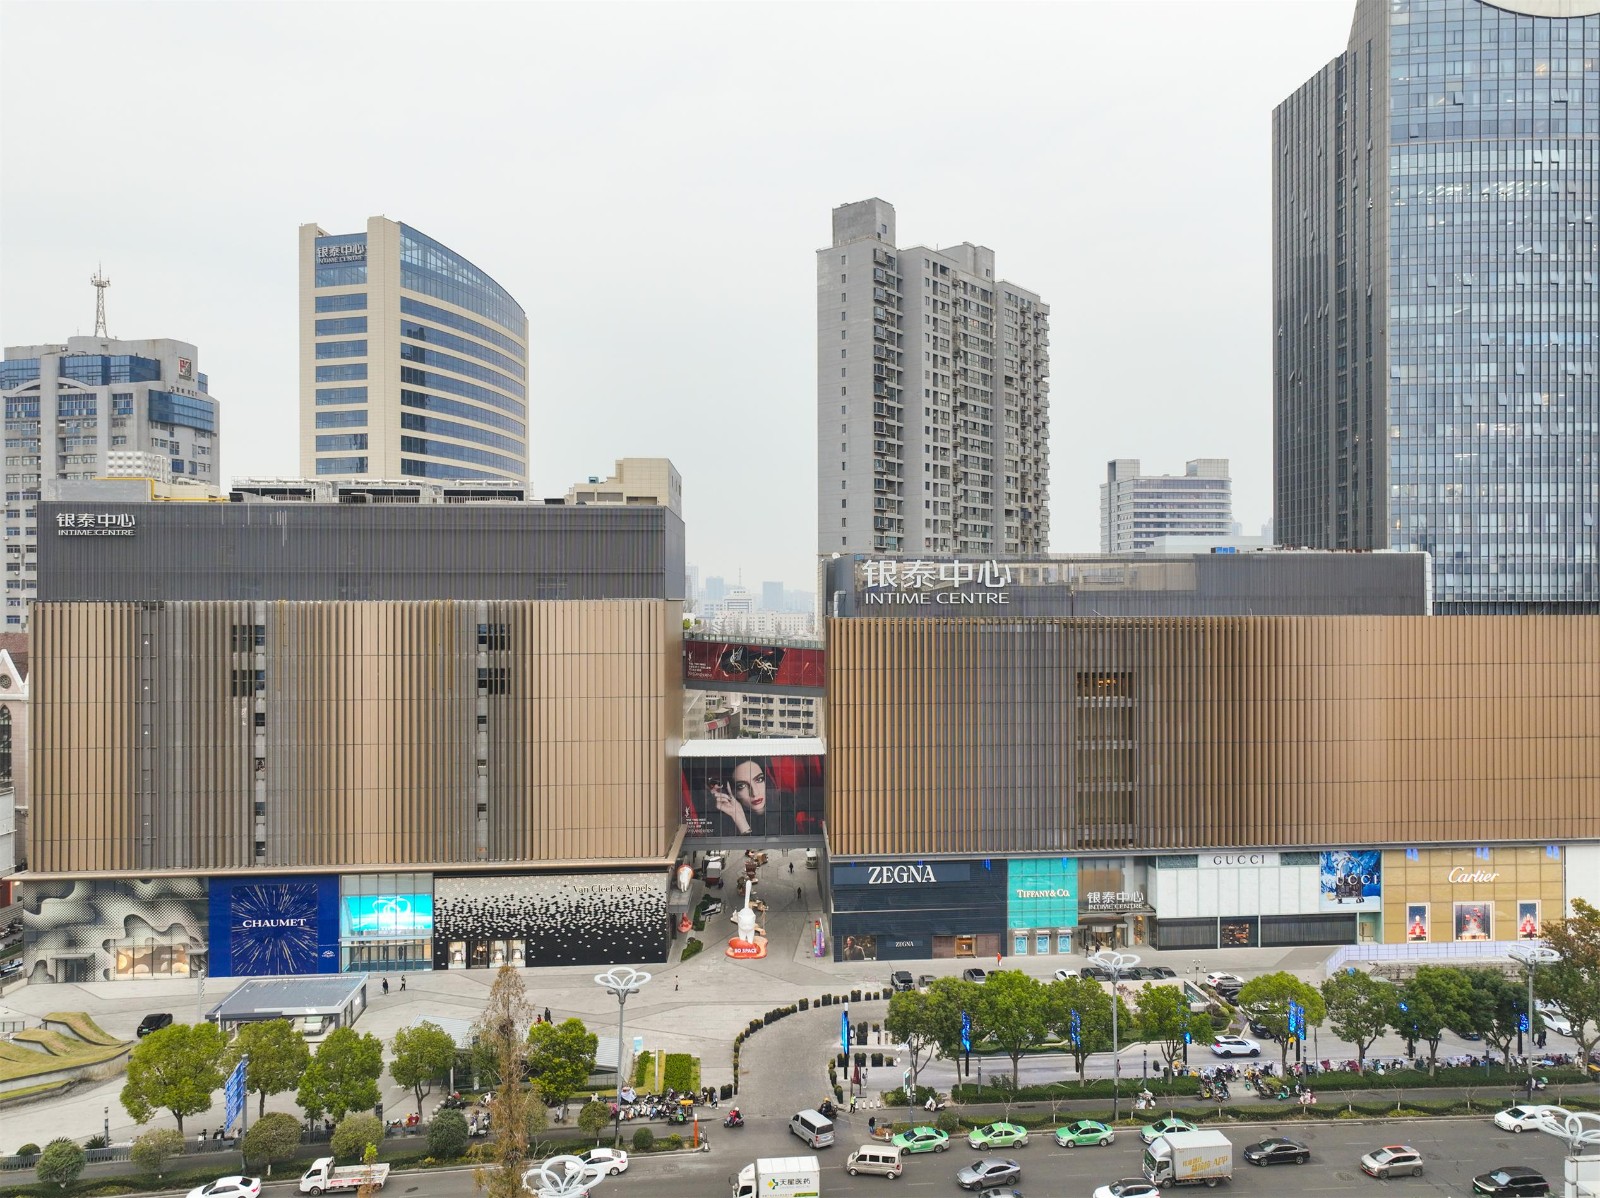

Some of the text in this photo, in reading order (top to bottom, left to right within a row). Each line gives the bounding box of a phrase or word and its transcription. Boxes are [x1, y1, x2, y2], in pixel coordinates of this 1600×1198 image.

[317, 243, 367, 257] 银泰中心
[56, 513, 136, 528] 银泰中心
[862, 559, 1012, 588] 银泰中心
[865, 592, 1010, 605] INTIME CENTRE
[1213, 854, 1266, 865] GUCCI
[868, 864, 937, 884] ZEGNA
[1448, 866, 1500, 883] Cartier
[573, 885, 589, 893] Van
[591, 884, 615, 893] Cleef
[624, 883, 652, 894] Arpels
[1087, 891, 1144, 904] 银泰中心
[242, 918, 307, 928] CHAUMET
